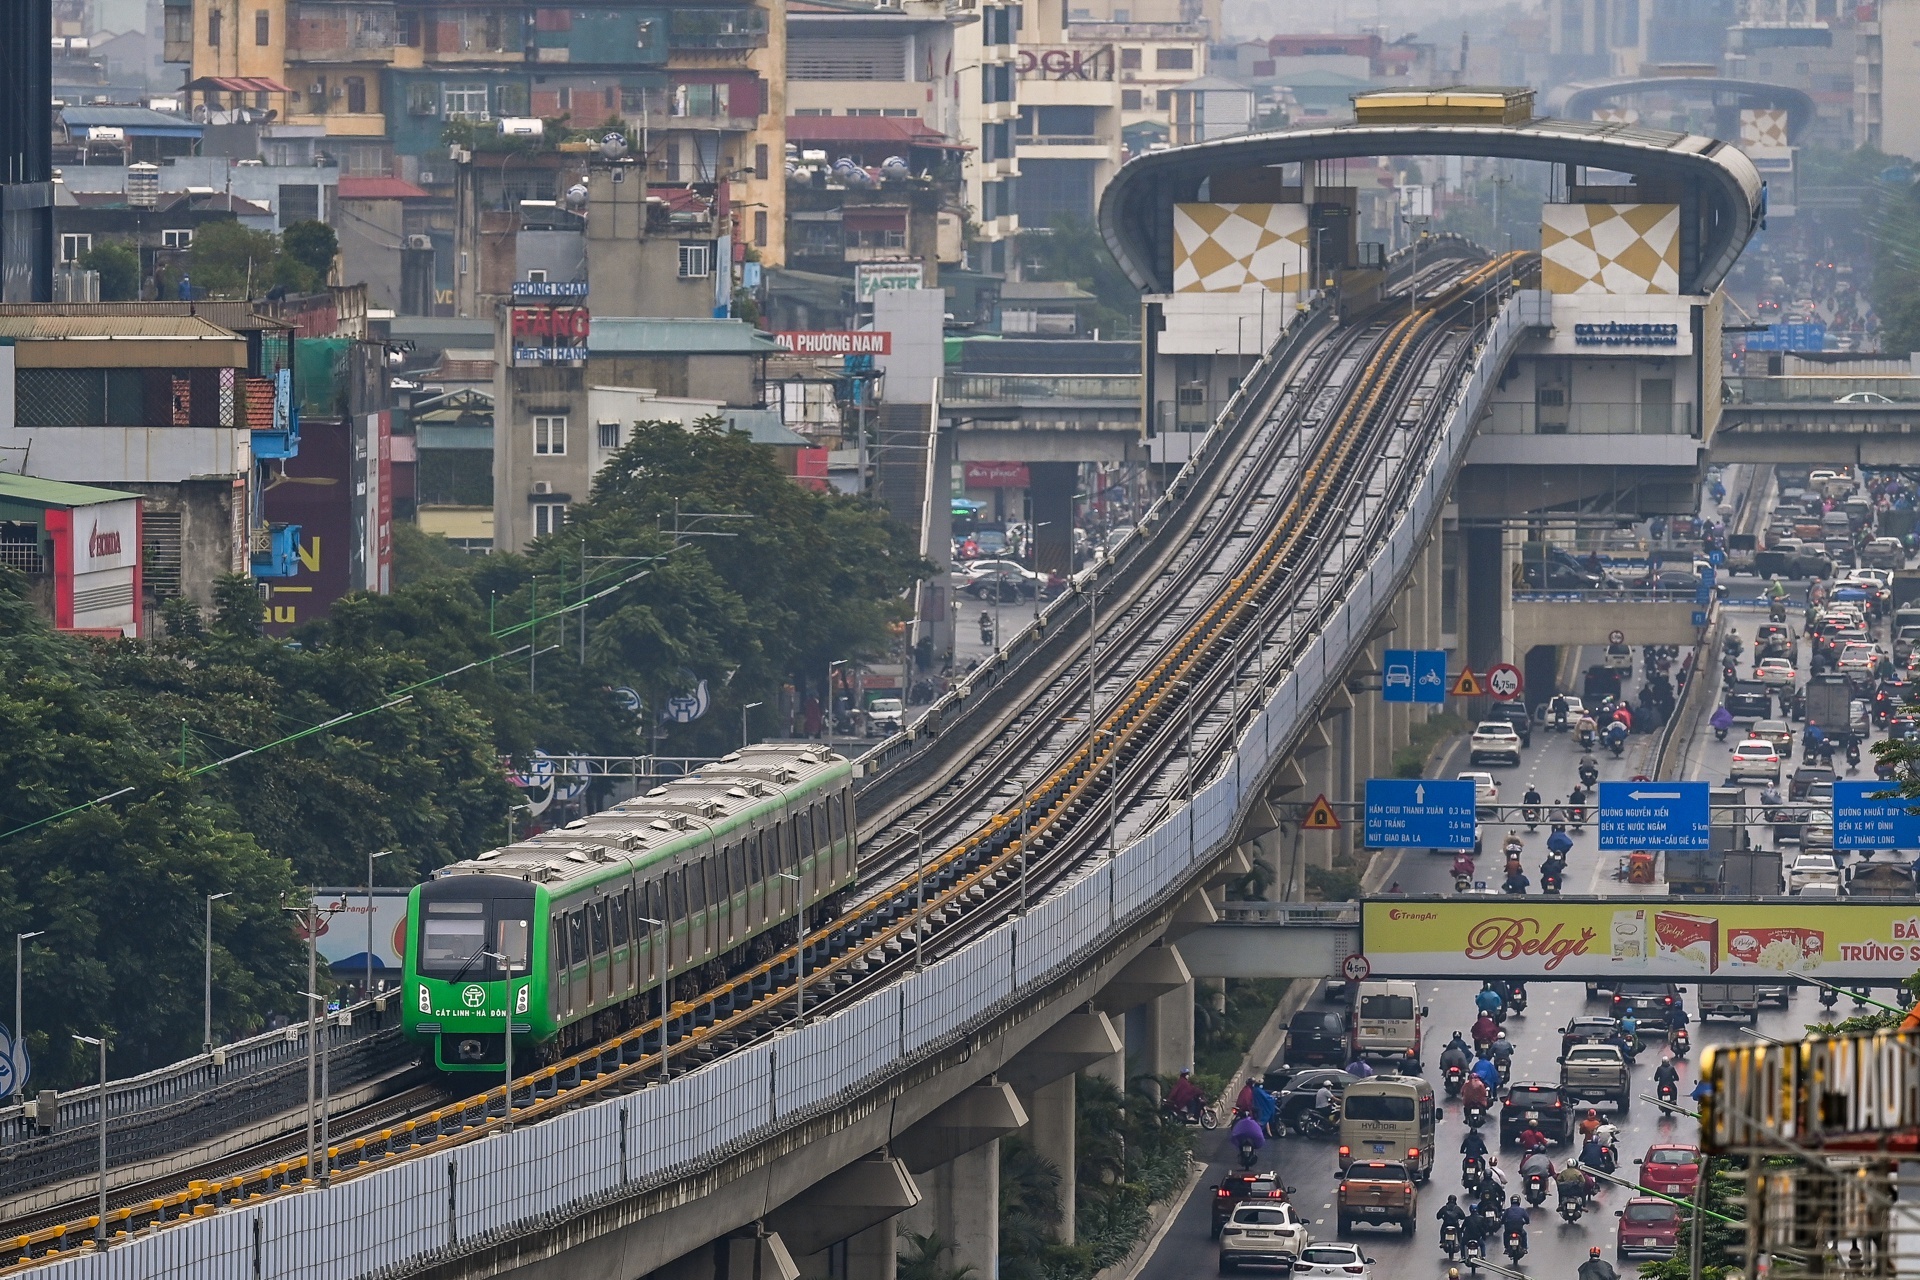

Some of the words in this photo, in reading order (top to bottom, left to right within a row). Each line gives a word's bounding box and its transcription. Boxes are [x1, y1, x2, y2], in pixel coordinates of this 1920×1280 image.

[797, 333, 850, 351] PHƯƠNG
[852, 335, 884, 351] NAM
[1493, 674, 1516, 690] 4,75m
[1386, 806, 1401, 814] CHUI
[1403, 806, 1424, 815] THANH
[1448, 807, 1459, 815] 0,3
[1460, 807, 1472, 815] km
[1887, 808, 1900, 817] DUY
[1448, 821, 1459, 829] 3,6
[1460, 821, 1471, 829] km
[1616, 822, 1625, 831] XE
[1692, 822, 1697, 831] 5
[1697, 822, 1709, 831] km
[1854, 822, 1863, 831] XE
[1385, 833, 1400, 842] GIAO
[1401, 834, 1410, 842] BA
[1413, 834, 1421, 842] LA
[1449, 835, 1459, 843] 7,1
[1460, 835, 1471, 843] km
[1601, 836, 1614, 845] CAO
[1691, 836, 1696, 845] 6
[1698, 836, 1709, 845] km
[1877, 835, 1895, 844] LONG
[1401, 911, 1438, 921] TrangAn
[1465, 917, 1596, 971] Belgi
[1840, 941, 1905, 962] TRỨNG
[1346, 961, 1366, 973] 4,5m
[452, 1009, 470, 1017] LINH
[476, 1008, 487, 1017] HÀ
[490, 1008, 507, 1017] ĐÔN
[1361, 1122, 1397, 1130] HYUNDAI
